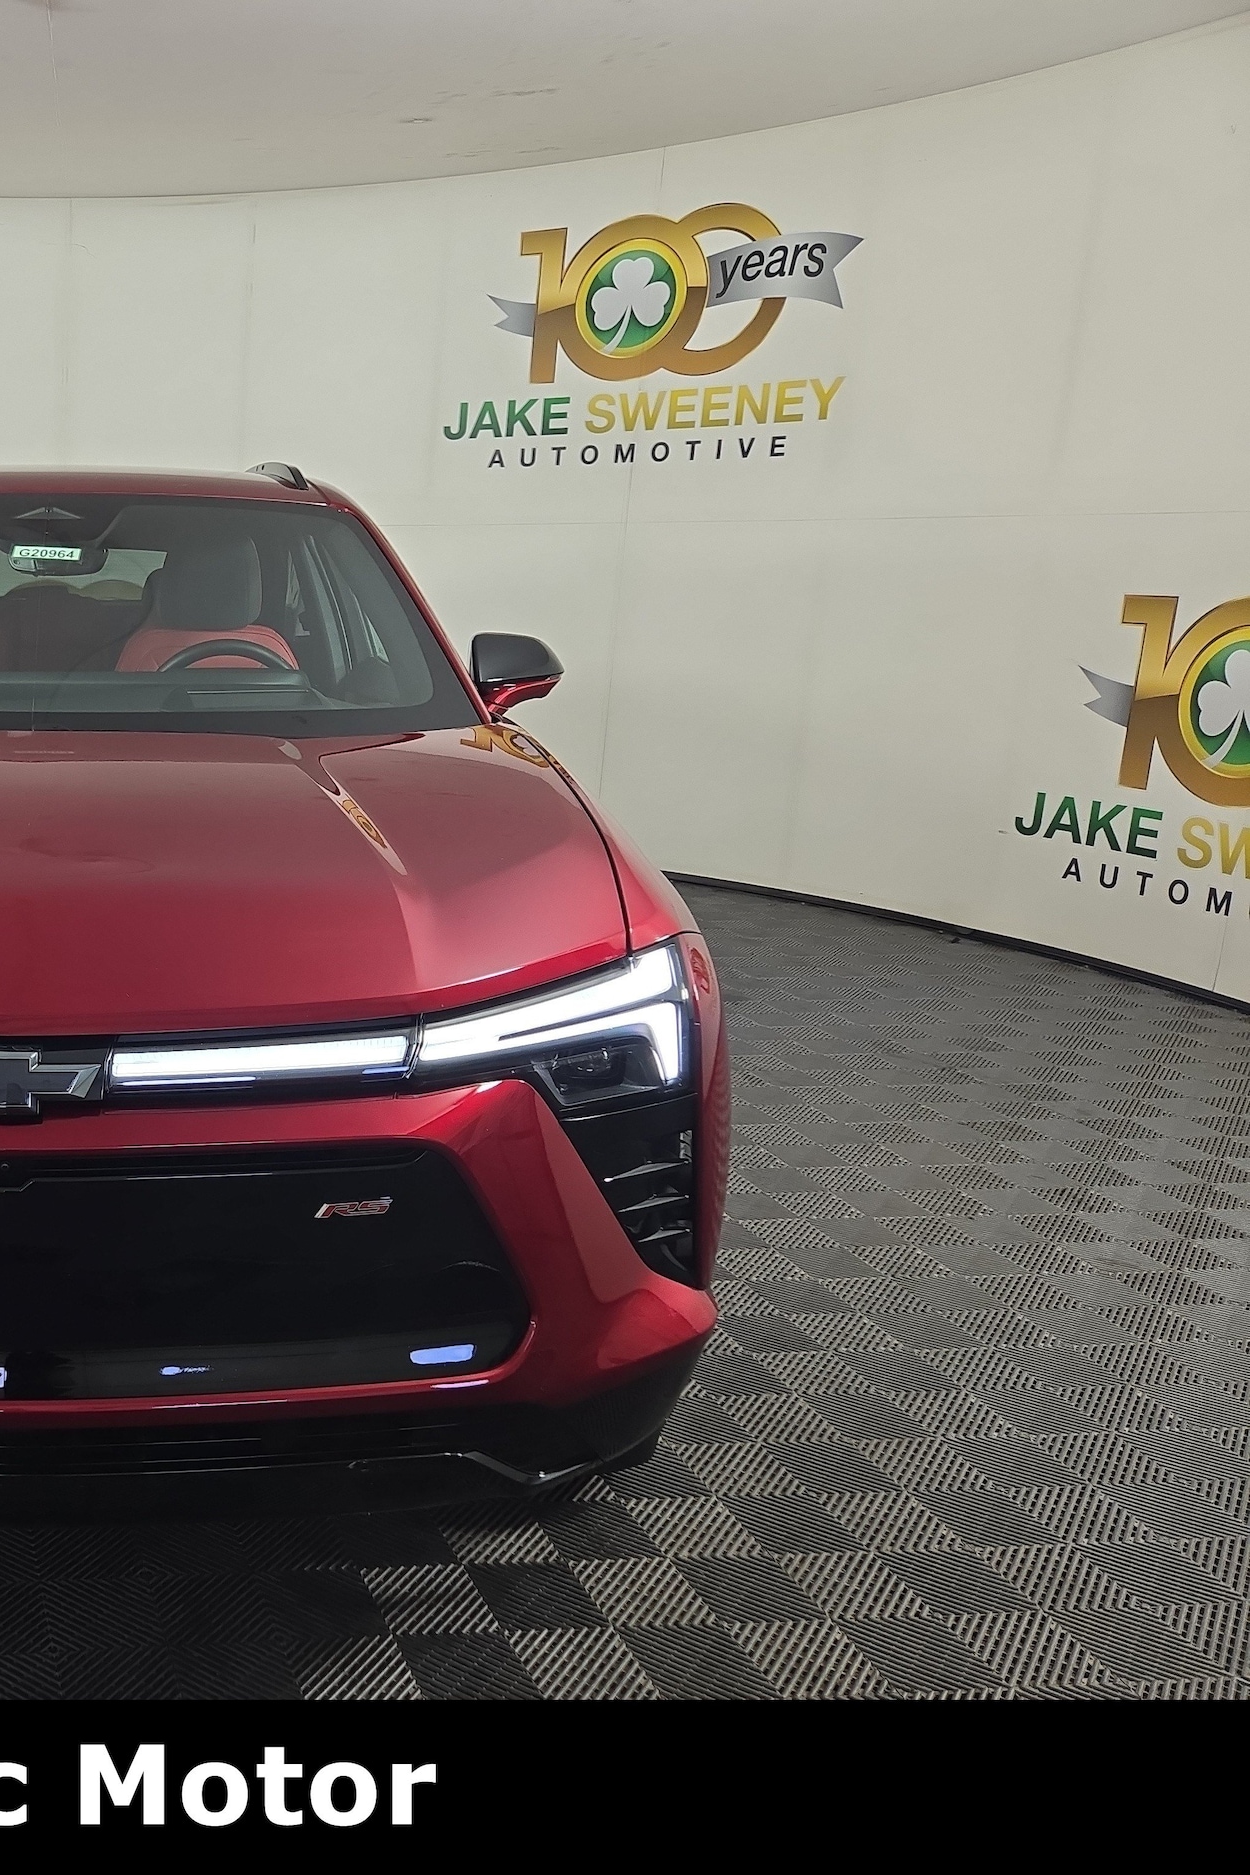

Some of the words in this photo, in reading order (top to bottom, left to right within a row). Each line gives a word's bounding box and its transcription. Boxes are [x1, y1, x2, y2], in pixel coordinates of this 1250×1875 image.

[715, 238, 827, 299] years
[443, 396, 571, 440] JAKE
[585, 376, 847, 435] SWEENEY
[488, 435, 787, 469] AUTOMOTIVE
[19, 548, 75, 559] G20964
[1014, 791, 1163, 860] JAKE
[1062, 857, 1250, 919] AUTOM
[314, 1198, 393, 1219] RS
